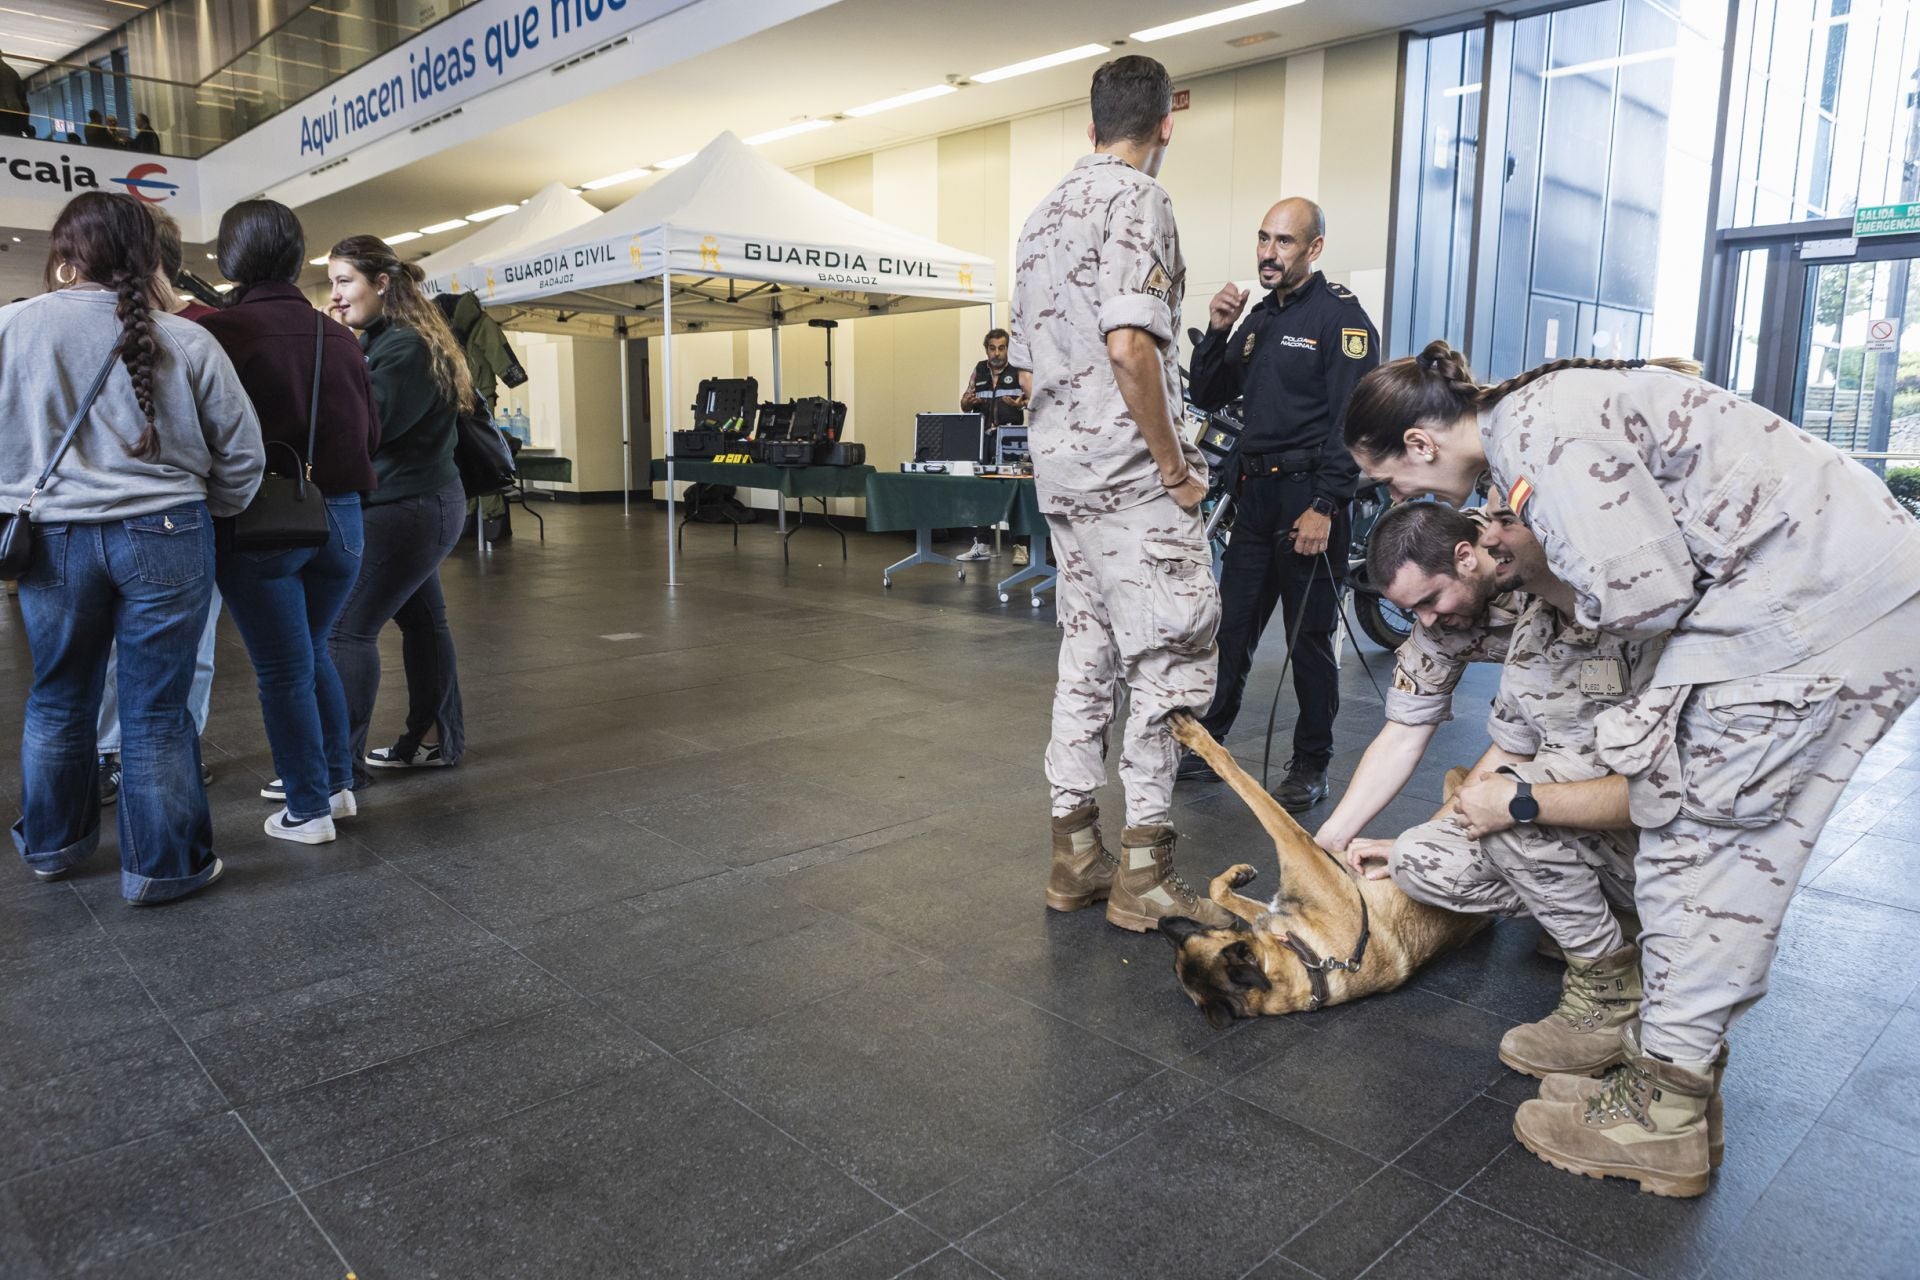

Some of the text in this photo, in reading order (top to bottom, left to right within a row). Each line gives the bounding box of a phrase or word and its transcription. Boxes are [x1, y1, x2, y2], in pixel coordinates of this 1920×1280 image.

[301, 95, 339, 155] Aquí
[344, 74, 403, 134] nacen
[410, 38, 475, 103] ideas
[485, 5, 540, 75] que
[1859, 205, 1920, 222] SALIDA DE
[1855, 218, 1920, 233] EMERGENCIA
[504, 244, 616, 283] GUARDIA CIVIL
[744, 242, 939, 279] GUARDIA CIVIL
[539, 273, 574, 289] BADAJOZ
[818, 273, 878, 286] BADAJOZ
